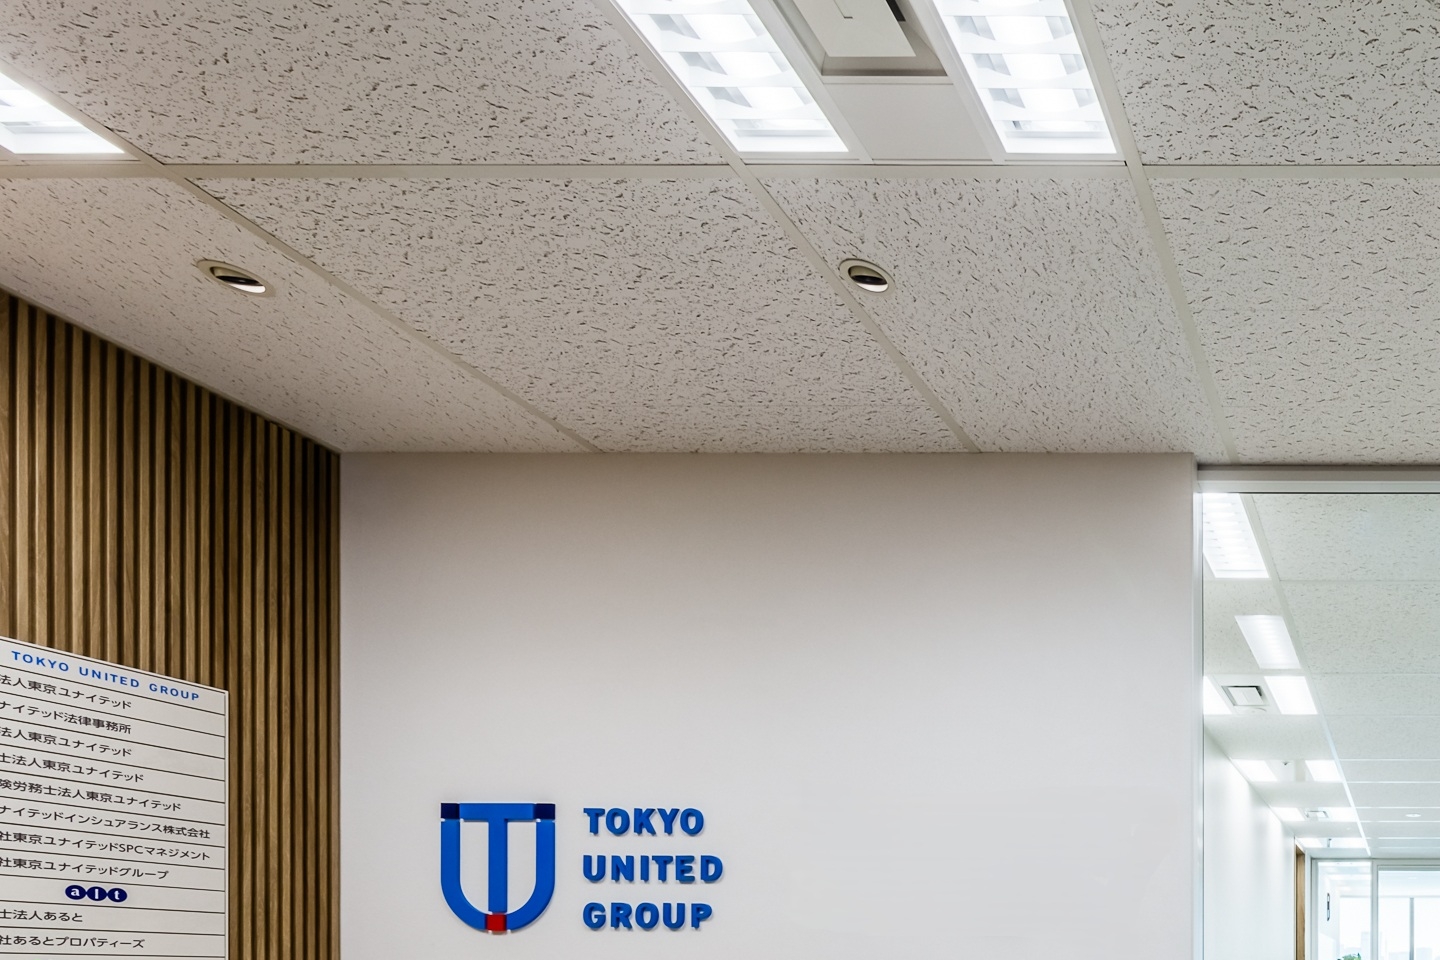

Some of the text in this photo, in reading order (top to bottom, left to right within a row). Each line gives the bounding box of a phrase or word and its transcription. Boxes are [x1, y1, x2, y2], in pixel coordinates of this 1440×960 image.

[11, 650, 200, 701] TOKYO UNITED GROUP
[0, 674, 132, 709] 法人東京ユナイテッド
[0, 702, 131, 735] ナイテッド法律事務所
[0, 726, 132, 757] 法人東京ユナイテッド
[0, 753, 144, 783] 士法人東京ユナイテッド
[583, 807, 705, 835] TOKYO
[582, 854, 723, 883] UNITED
[67, 886, 125, 902] alt
[0, 909, 83, 923] 士法人あると
[582, 902, 713, 930] GROUP
